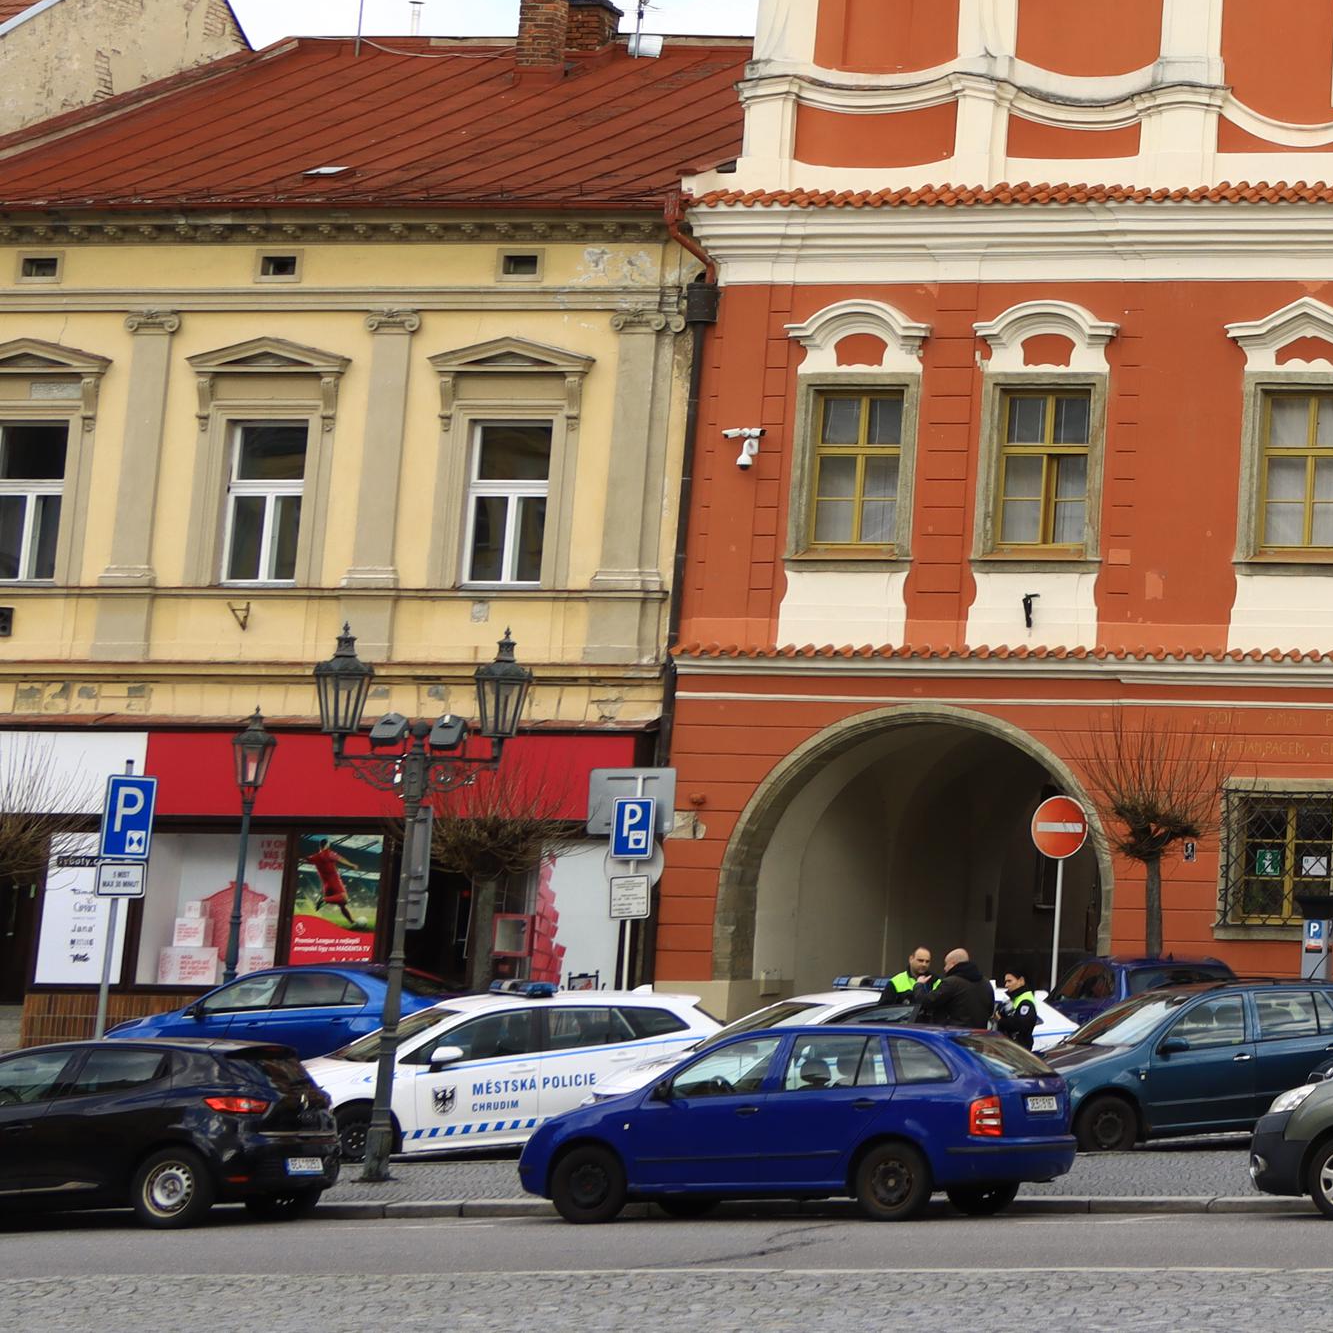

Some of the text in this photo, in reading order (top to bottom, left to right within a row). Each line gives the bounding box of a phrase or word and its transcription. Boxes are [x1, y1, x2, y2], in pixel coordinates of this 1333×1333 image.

[113, 786, 145, 833] P
[622, 803, 643, 837] P
[1310, 923, 1319, 937] P
[472, 1072, 597, 1096] MĚSTSKÁ POLICIE
[471, 1099, 519, 1112] CHRUDIM
